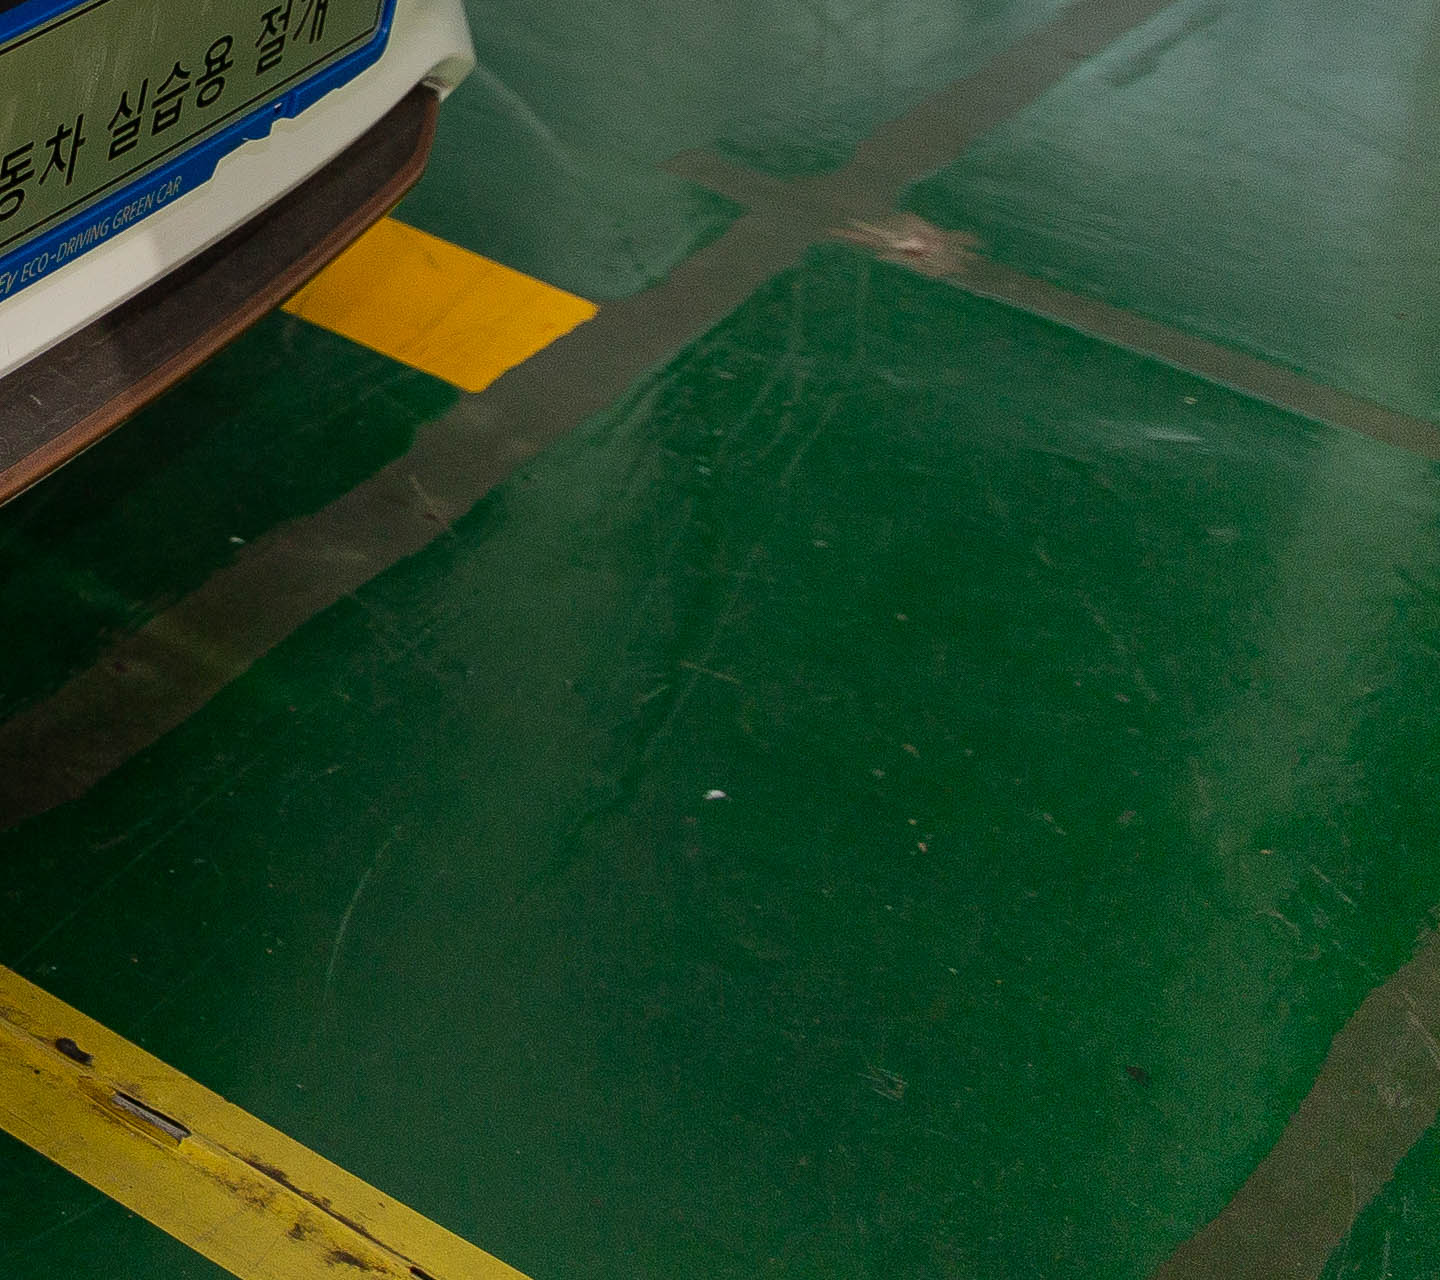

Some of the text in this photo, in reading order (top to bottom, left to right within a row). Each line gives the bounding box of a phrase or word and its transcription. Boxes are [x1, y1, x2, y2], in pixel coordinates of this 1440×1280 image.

[108, 35, 234, 161] 실습용
[20, 216, 111, 283] ECO-DRIVING
[111, 190, 157, 231] GREEN
[156, 175, 183, 204] CAR
